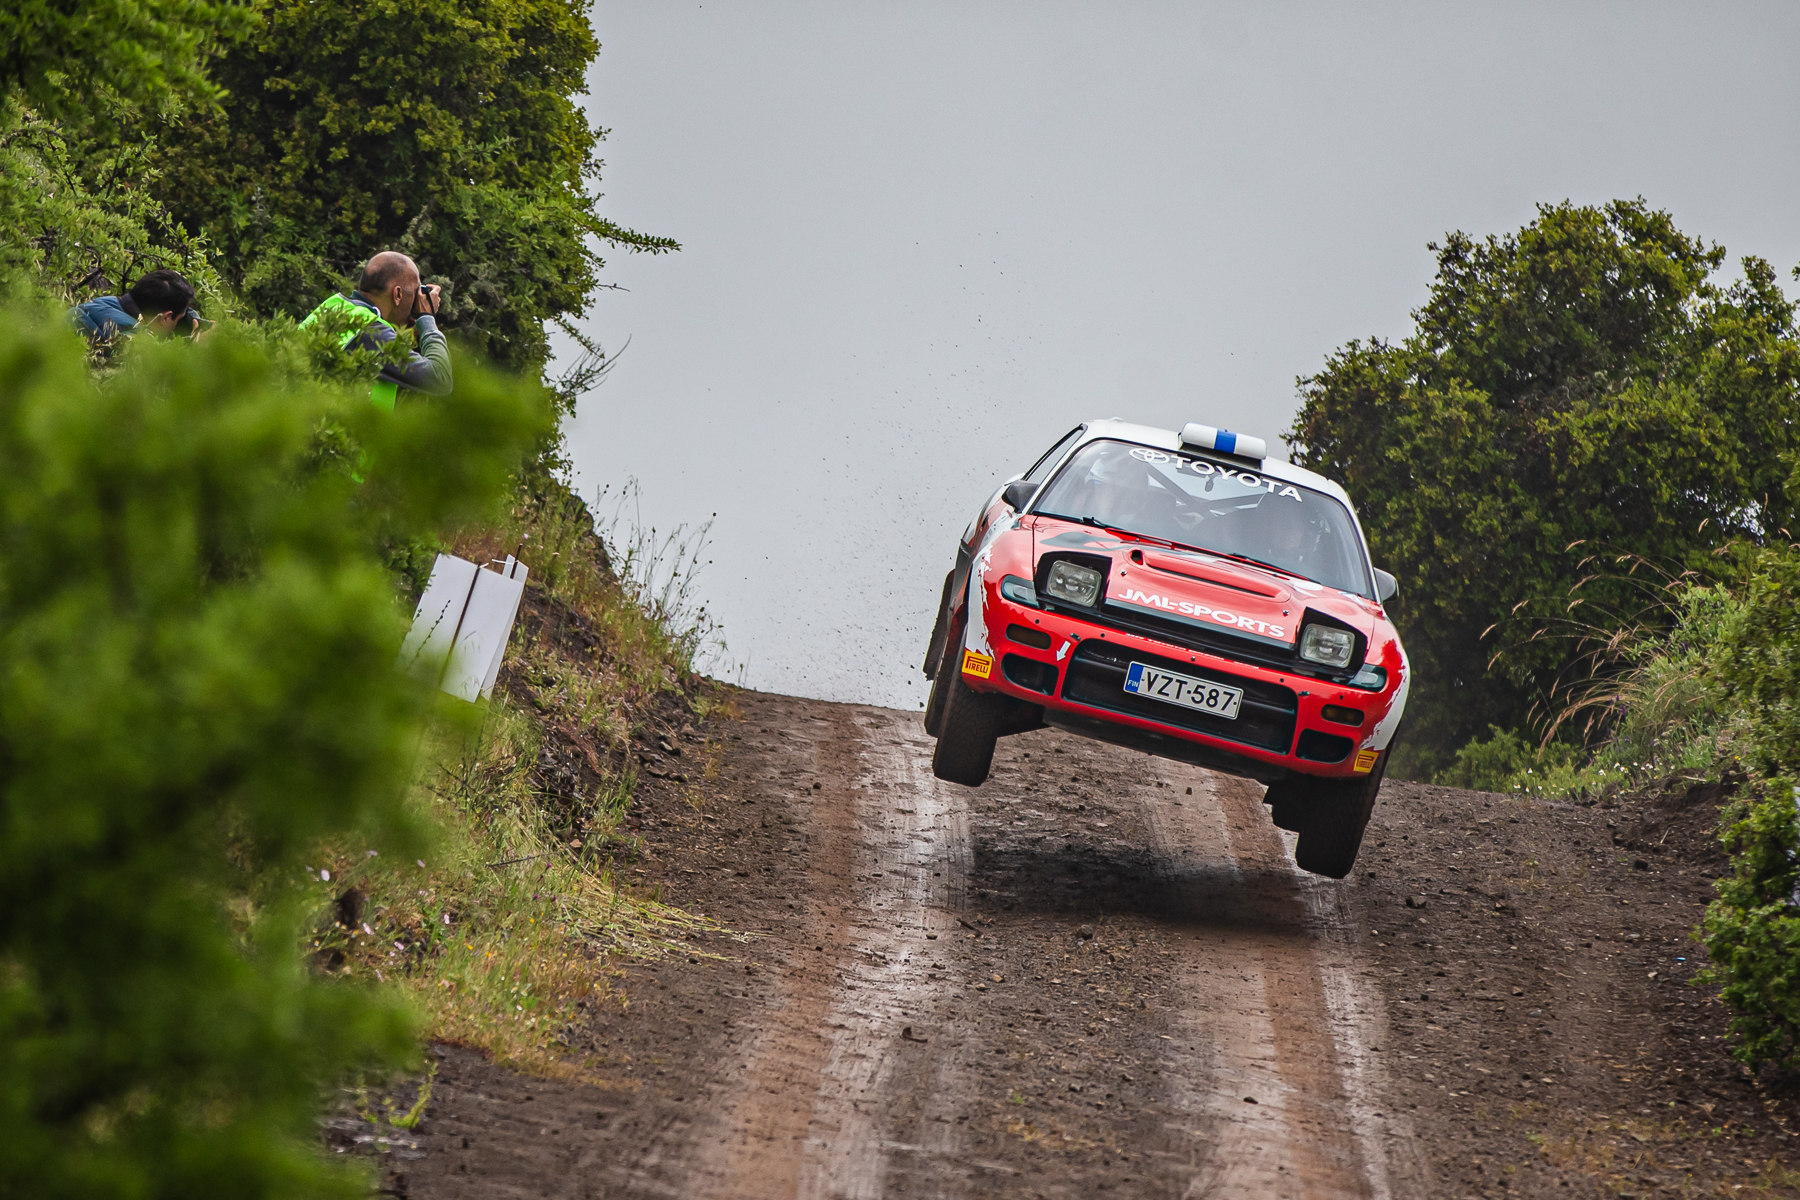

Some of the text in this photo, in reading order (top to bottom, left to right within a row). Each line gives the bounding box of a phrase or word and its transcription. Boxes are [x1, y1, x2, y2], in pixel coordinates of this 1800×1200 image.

[1171, 455, 1302, 502] TOYOTA
[1118, 588, 1285, 638] JML-SPORTS
[965, 656, 990, 674] PIRELLI
[1127, 679, 1140, 688] FIN
[1146, 671, 1236, 711] VZT-587
